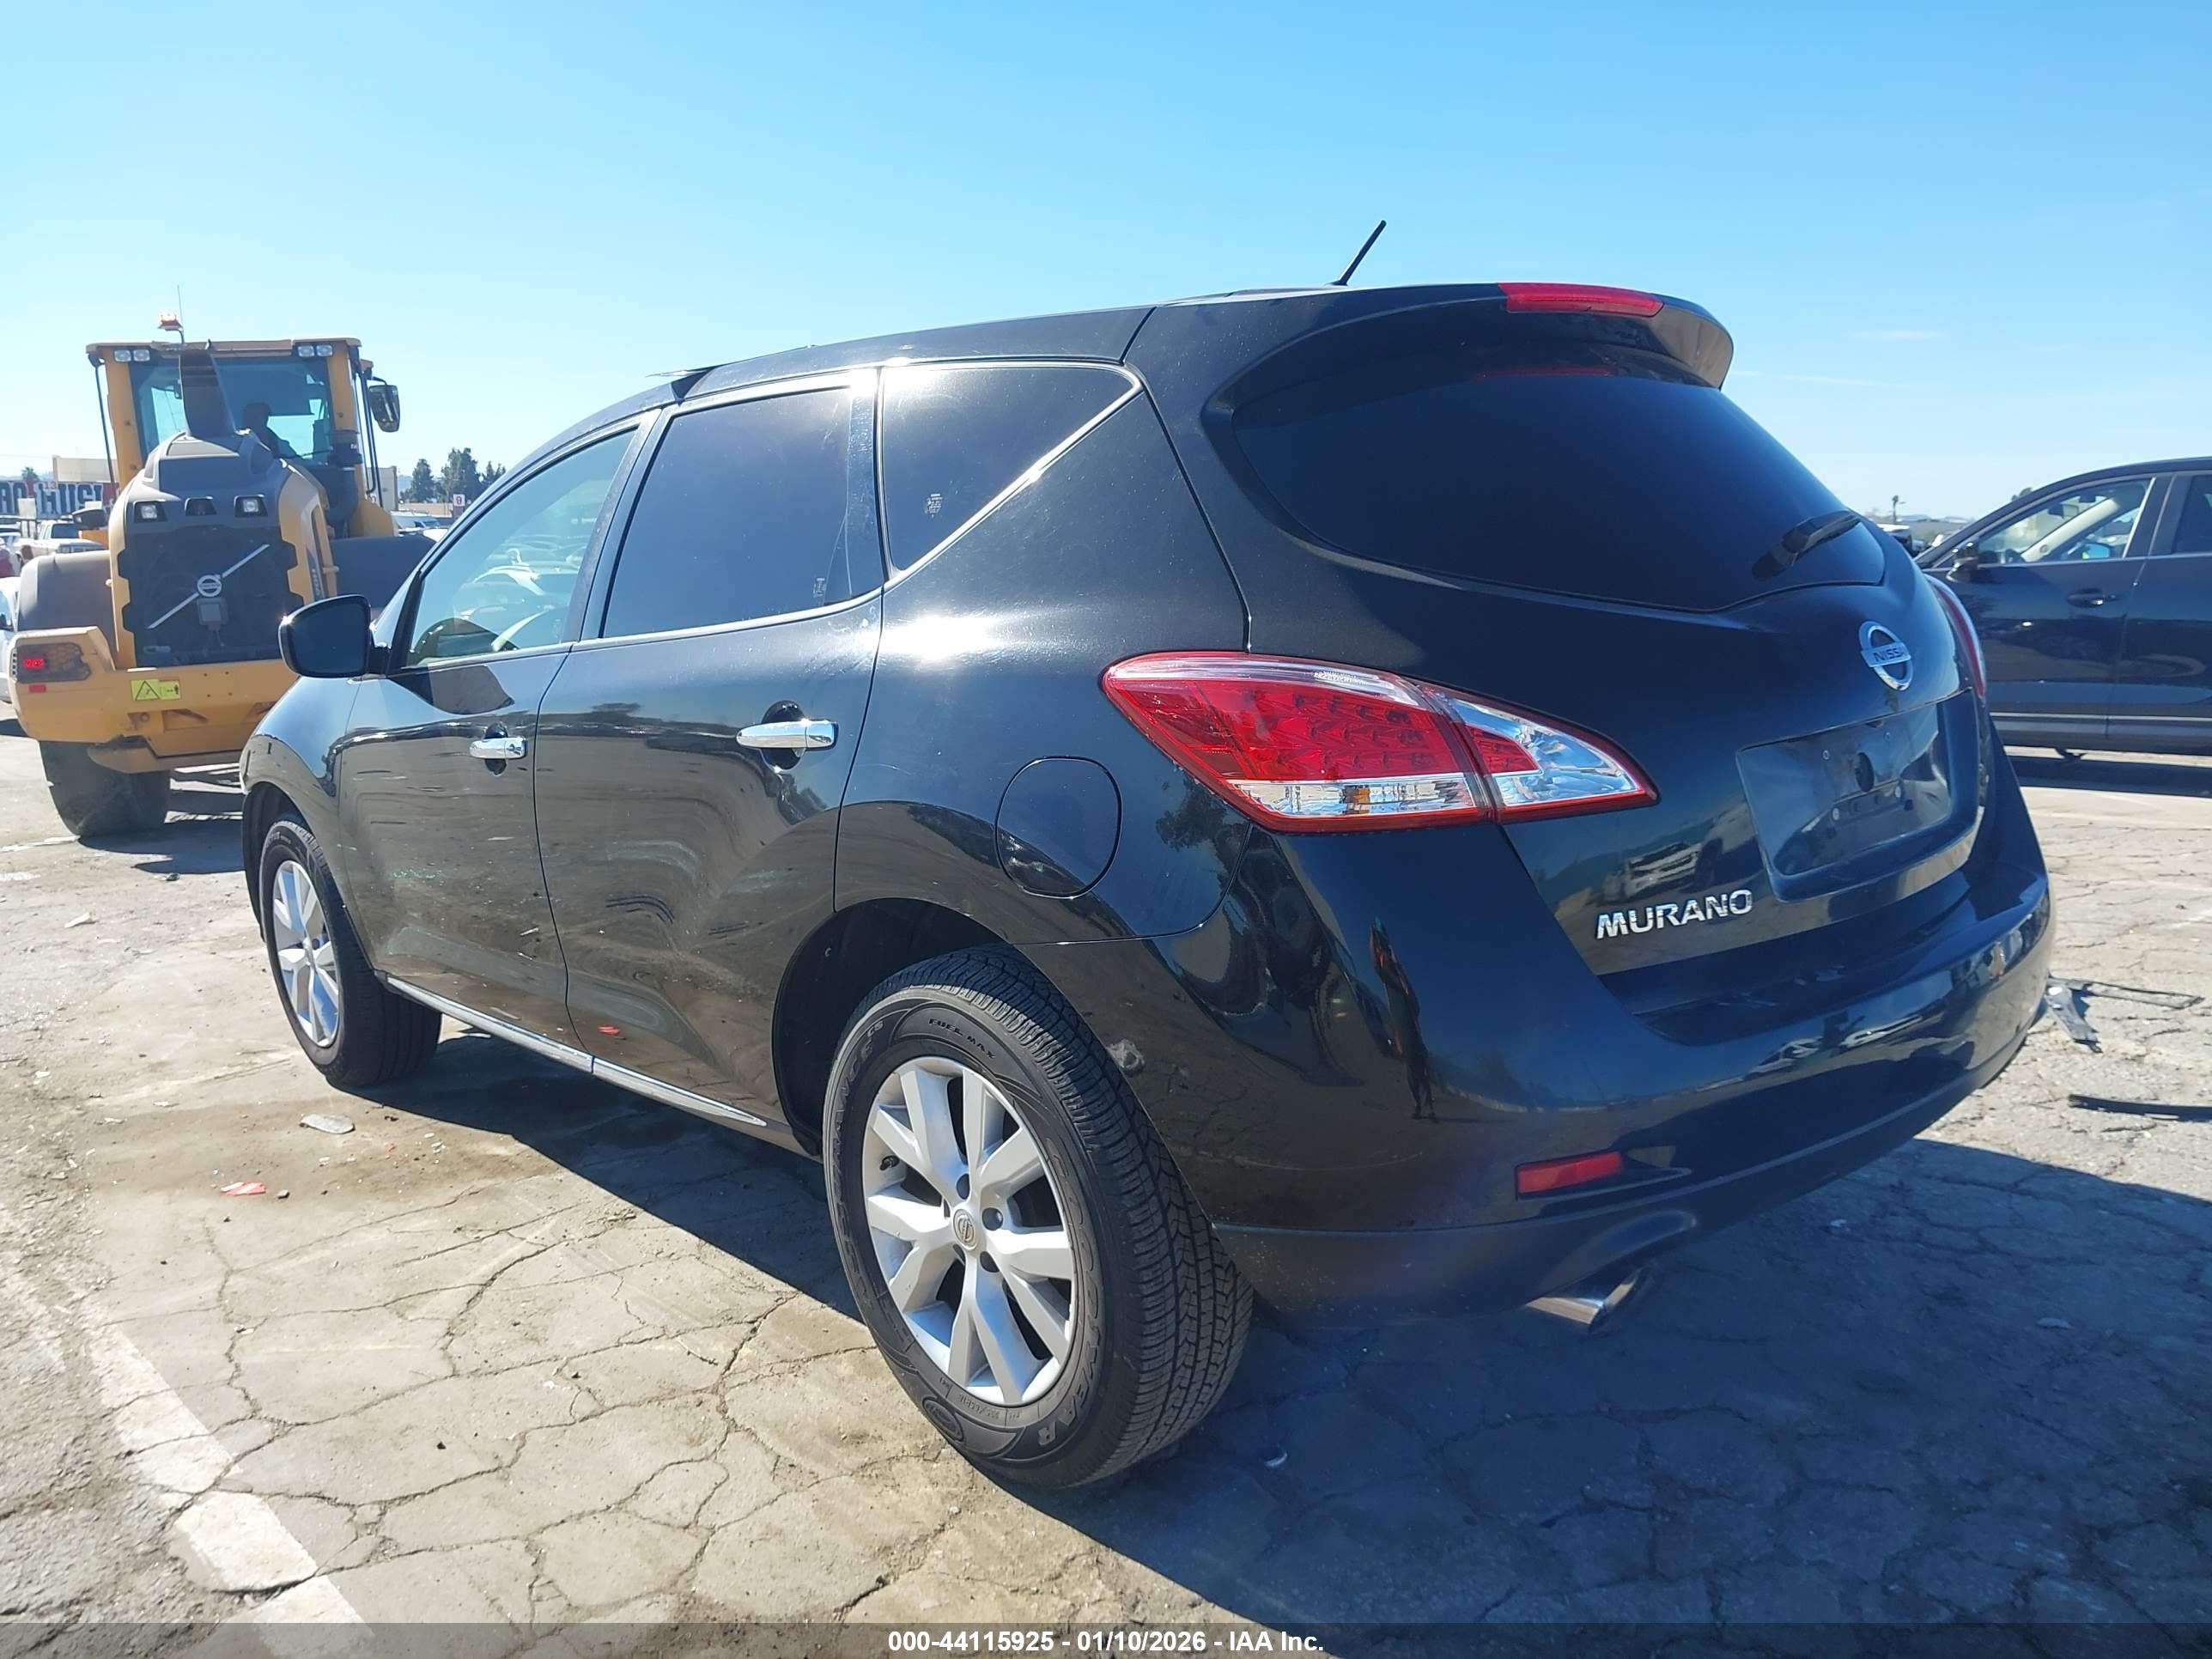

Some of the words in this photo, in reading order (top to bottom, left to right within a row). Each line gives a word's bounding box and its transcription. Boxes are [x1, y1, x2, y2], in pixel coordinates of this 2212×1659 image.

[1873, 647, 1905, 662] NISS
[1596, 889, 1753, 939] MURANO
[928, 1018, 963, 1036] FUEL
[966, 1036, 996, 1059] MAX
[1037, 1136, 1101, 1446] GOODYEAR
